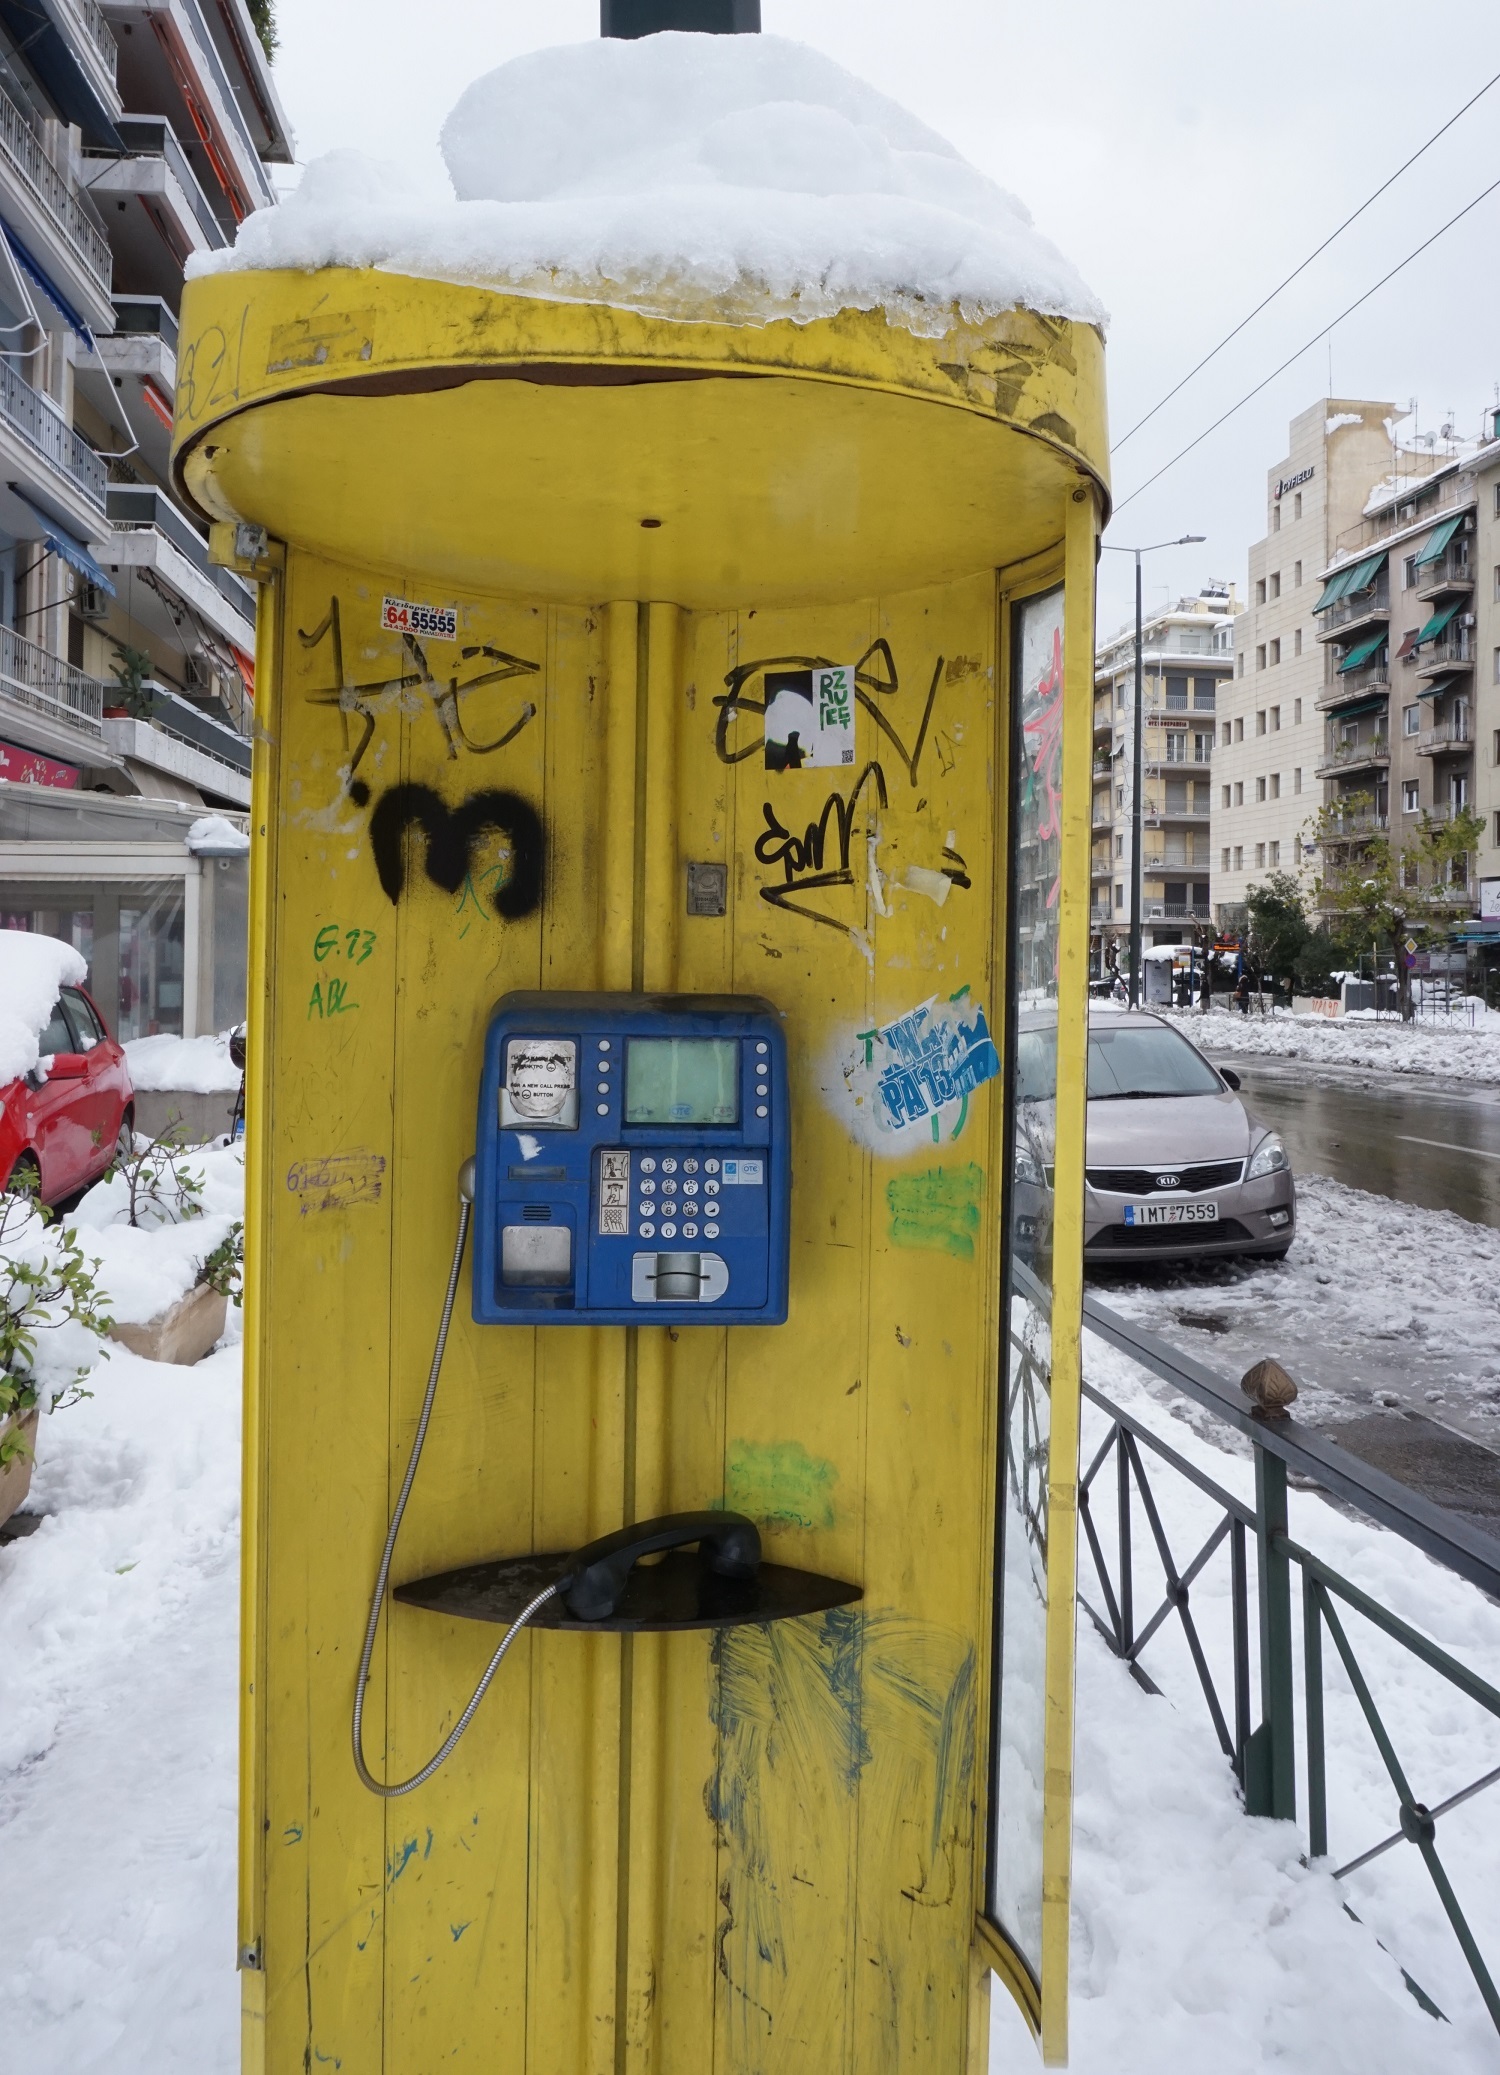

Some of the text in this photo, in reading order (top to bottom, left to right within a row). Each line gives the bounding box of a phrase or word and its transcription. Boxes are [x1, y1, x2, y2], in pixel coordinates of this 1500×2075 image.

[1283, 467, 1314, 492] CYFIELD
[435, 607, 444, 615] 24
[384, 623, 418, 633] 64.43000
[1160, 1177, 1177, 1185] KIA
[1140, 1207, 1167, 1223] IMT
[1176, 1204, 1216, 1220] 7559
